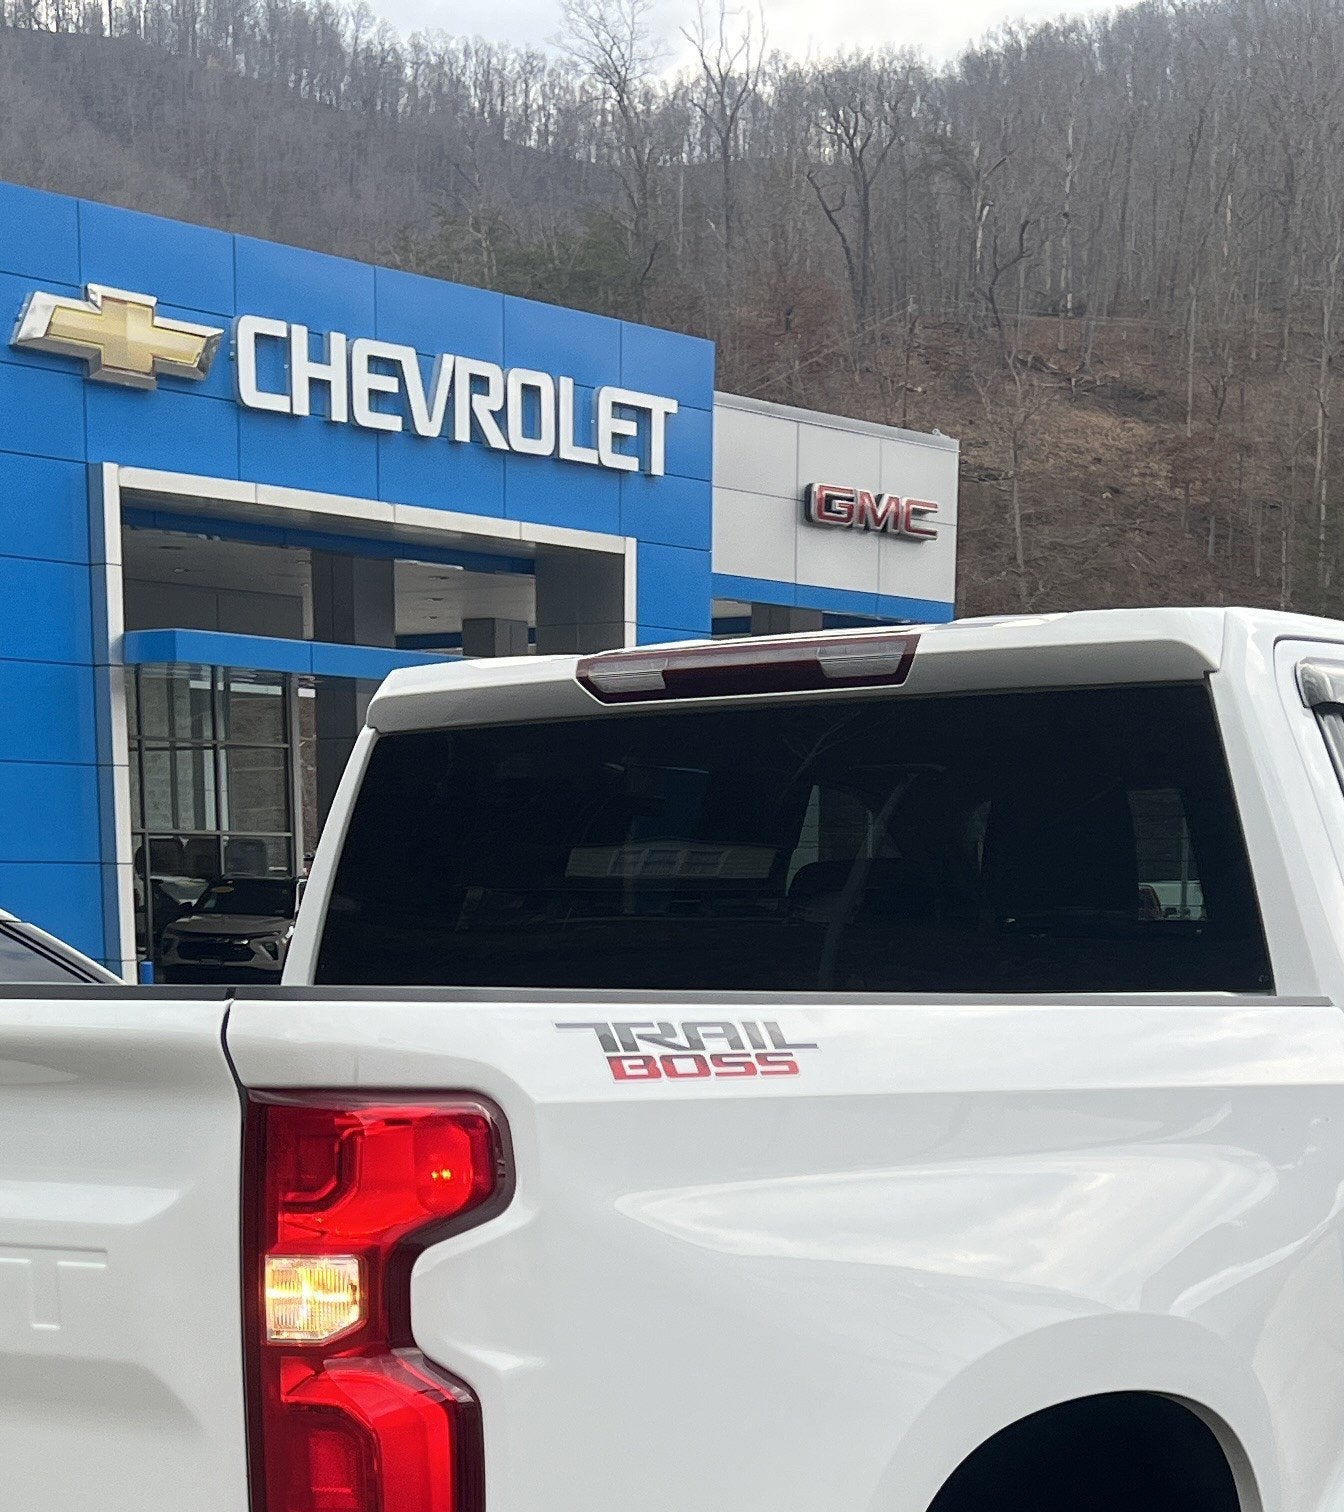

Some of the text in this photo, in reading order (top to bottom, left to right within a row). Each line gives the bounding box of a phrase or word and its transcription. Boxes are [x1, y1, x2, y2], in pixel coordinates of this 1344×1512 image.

[235, 314, 678, 476] CHEVROLET
[805, 482, 938, 541] GMC
[554, 1021, 819, 1052] TRAIL
[606, 1052, 801, 1082] BOSS
